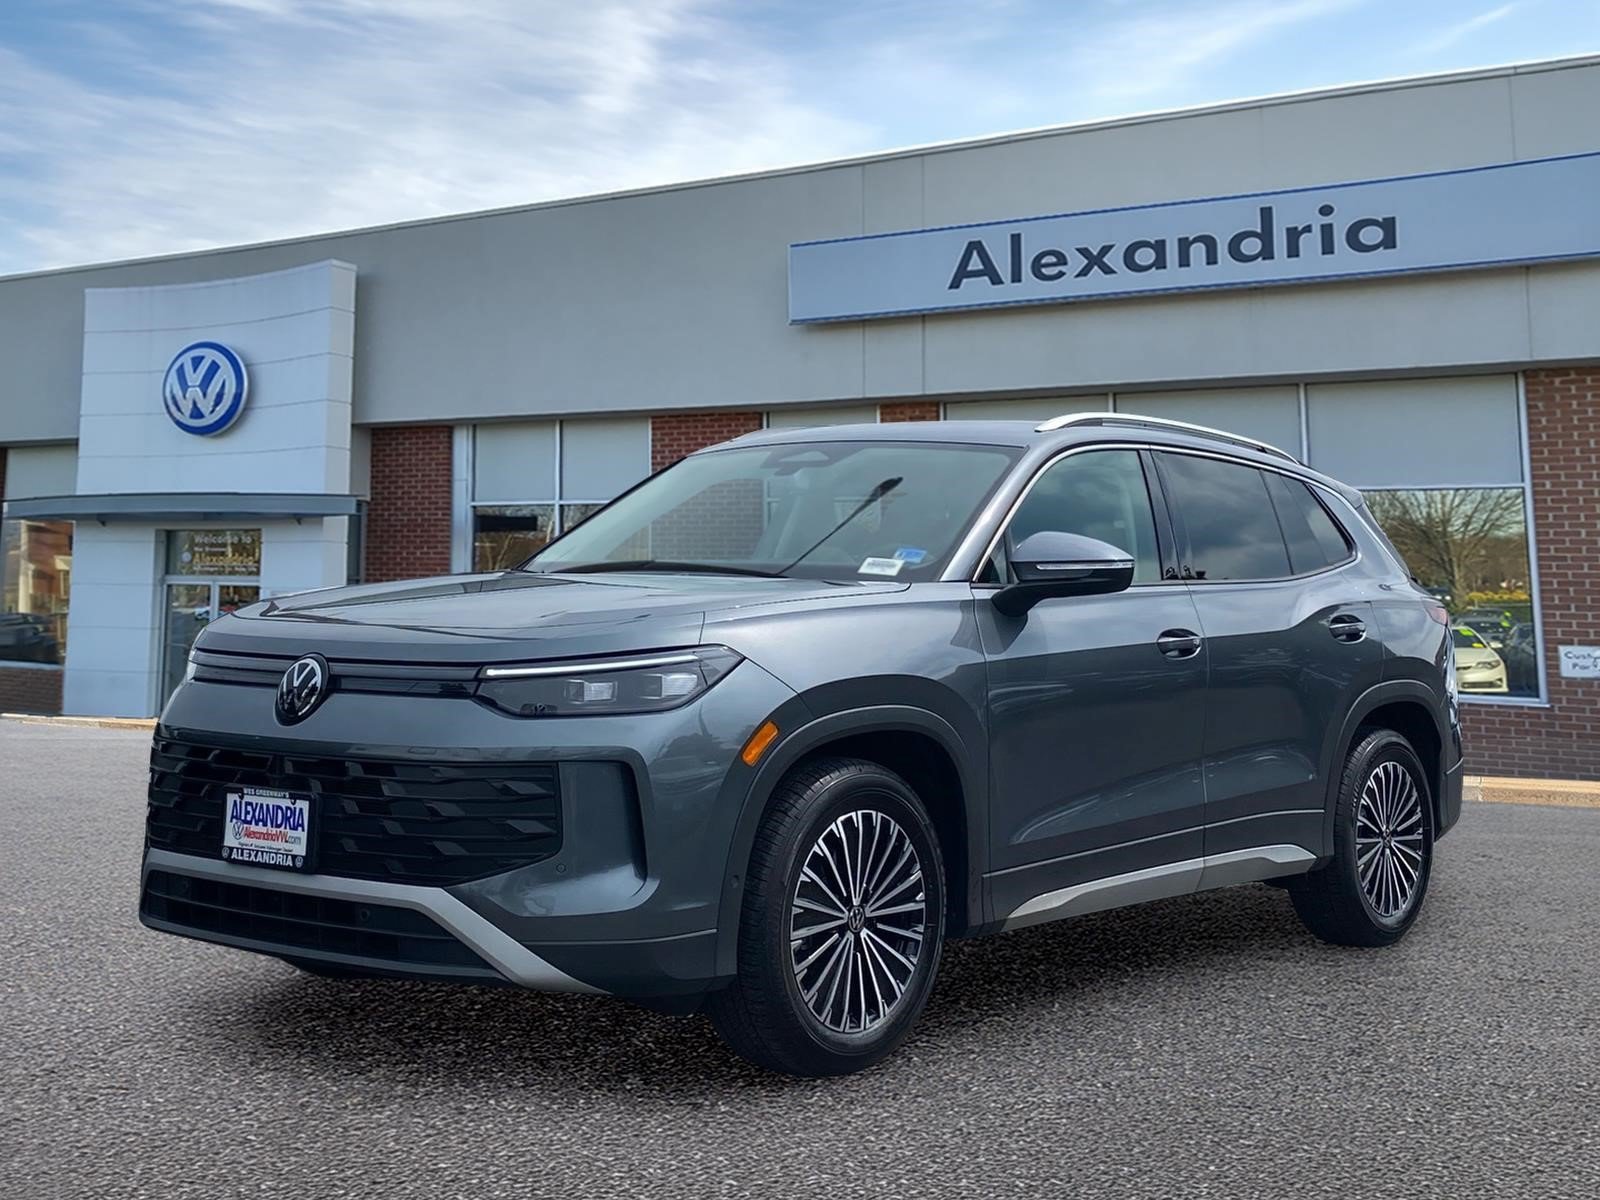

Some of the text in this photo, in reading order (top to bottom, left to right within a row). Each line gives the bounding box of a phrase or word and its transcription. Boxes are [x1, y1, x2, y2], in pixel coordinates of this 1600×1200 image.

[948, 204, 1397, 290] Alexandria
[230, 799, 305, 833] ALEXANDRIA
[231, 847, 294, 867] ALEXANDRIA
